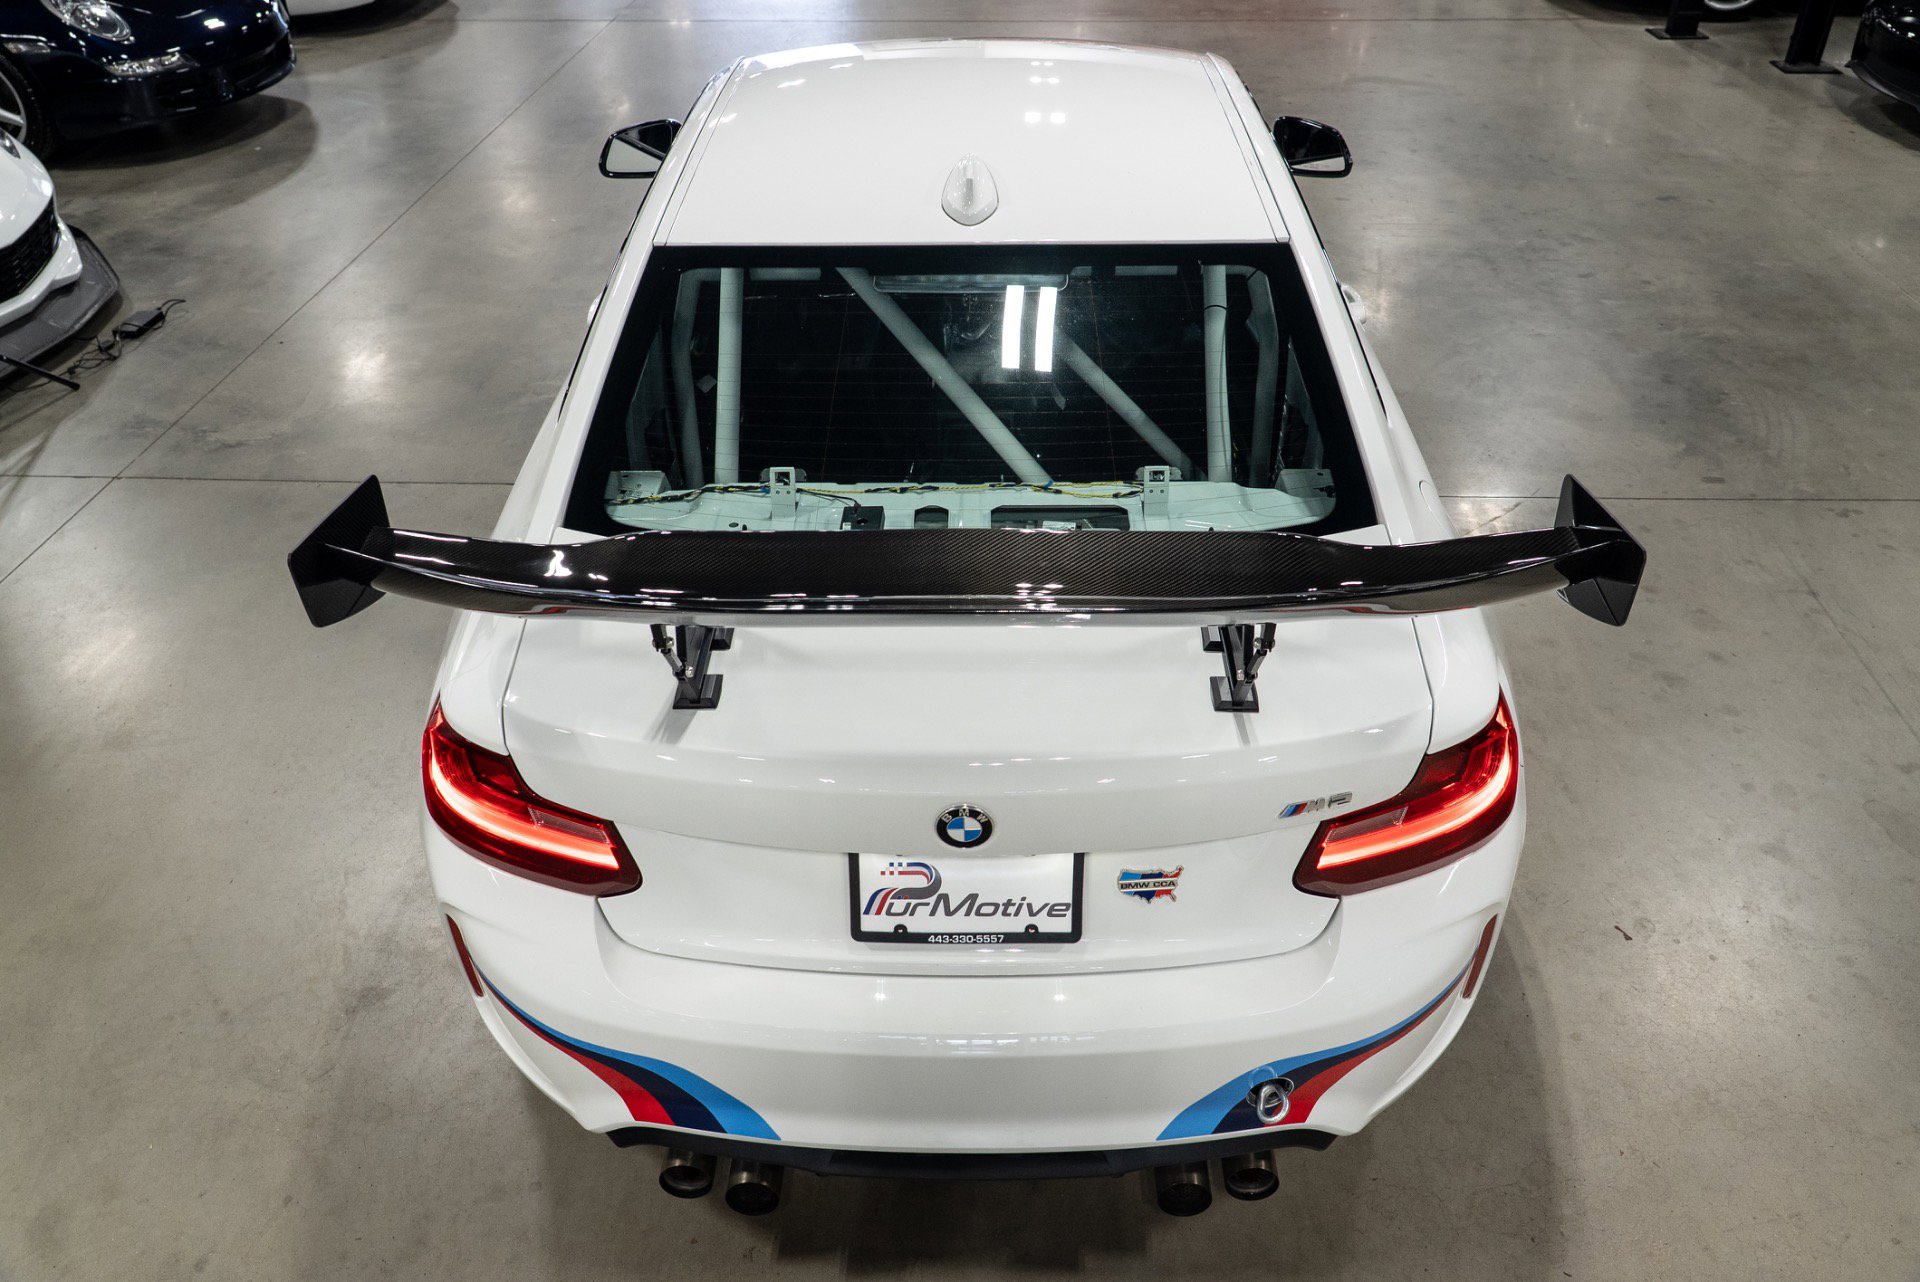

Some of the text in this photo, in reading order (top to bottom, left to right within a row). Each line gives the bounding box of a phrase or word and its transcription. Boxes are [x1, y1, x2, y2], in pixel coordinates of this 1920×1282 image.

[941, 807, 988, 823] BMW
[1120, 880, 1176, 890] BMW CCA
[927, 934, 1005, 944] 443-330-5557
